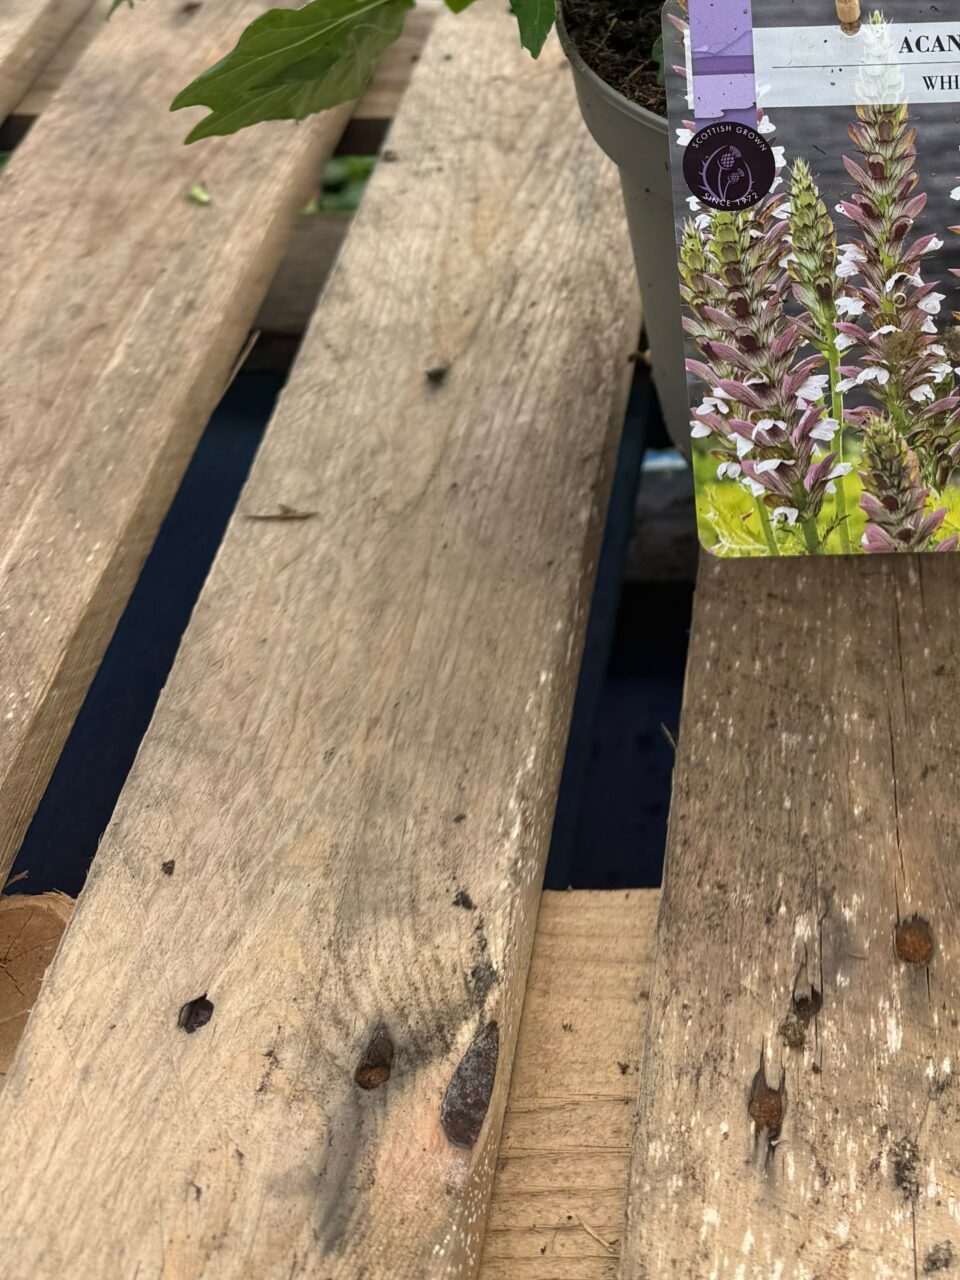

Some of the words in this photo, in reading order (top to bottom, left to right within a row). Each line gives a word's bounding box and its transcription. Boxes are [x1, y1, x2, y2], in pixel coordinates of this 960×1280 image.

[692, 125, 732, 148] SCOTTISH
[736, 126, 767, 151] GROWN
[703, 192, 731, 207] SINCE
[737, 192, 758, 206] 1972
